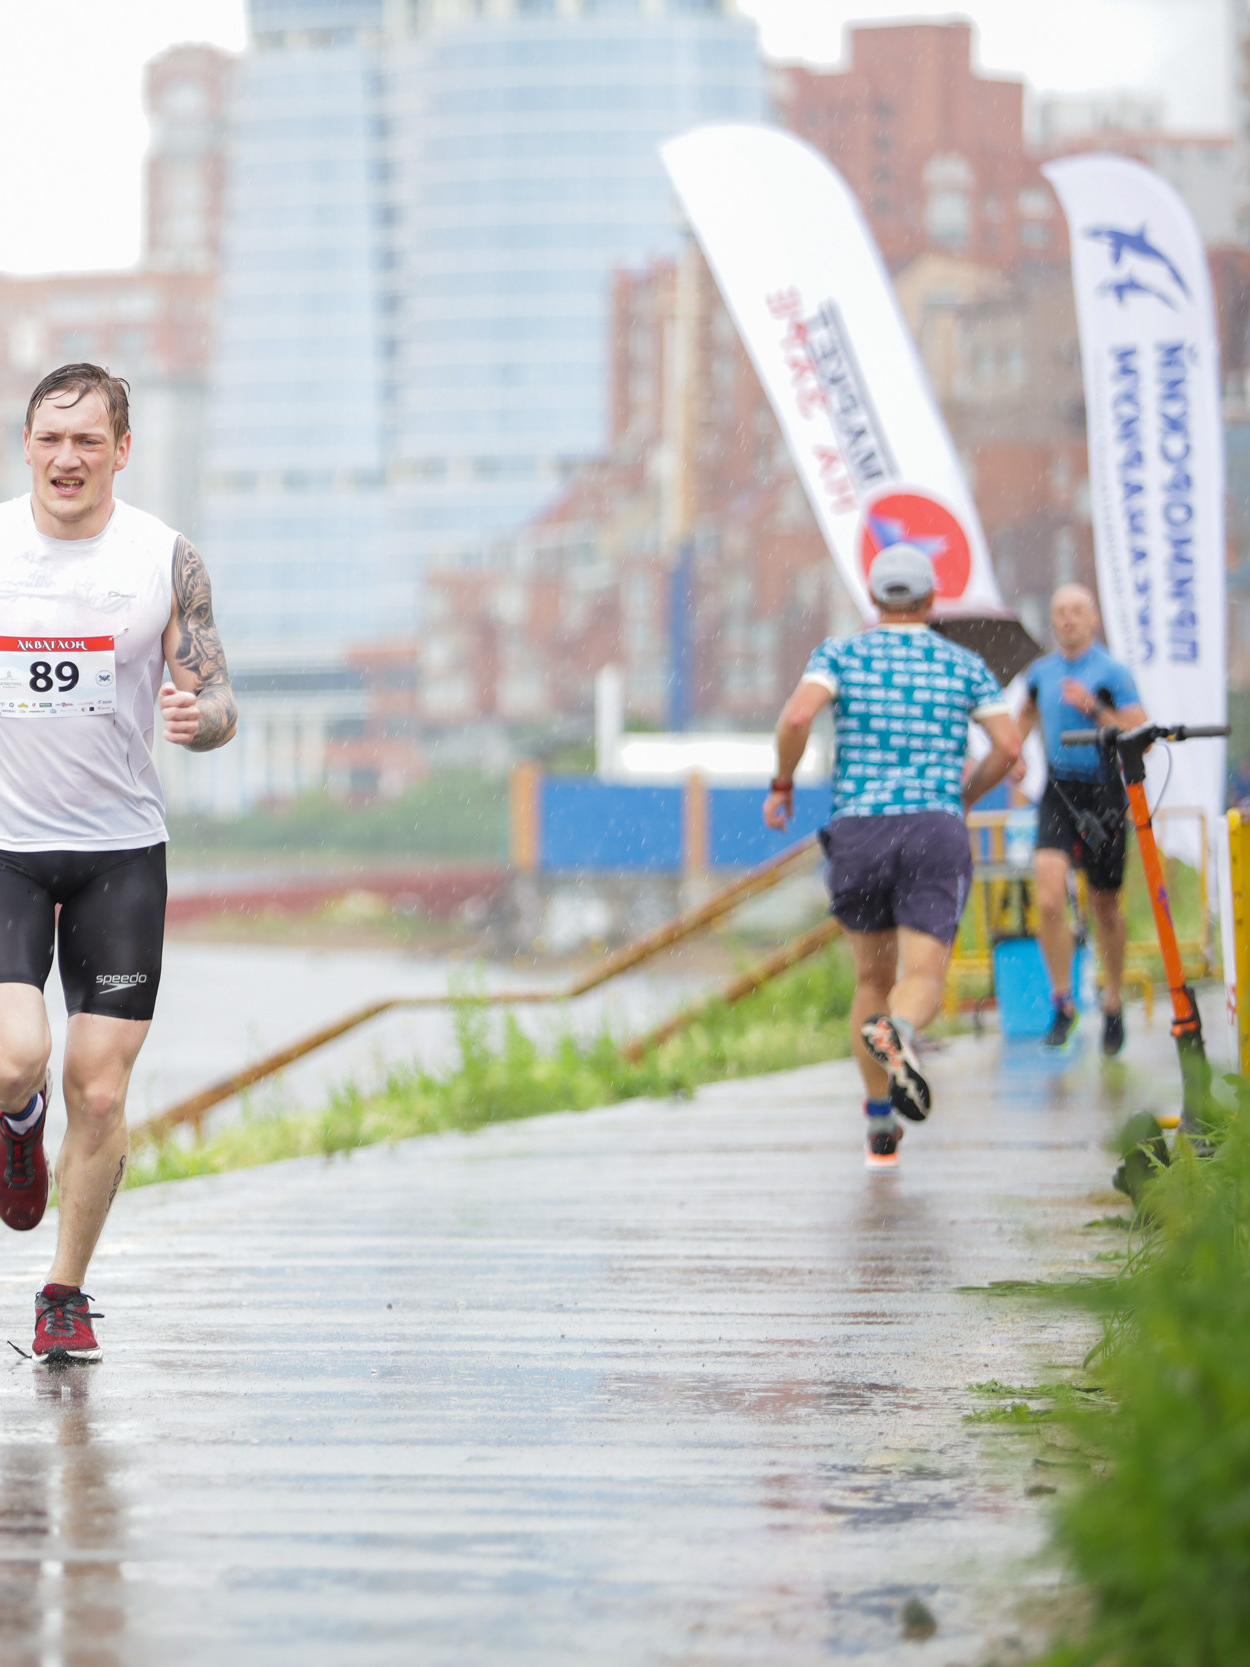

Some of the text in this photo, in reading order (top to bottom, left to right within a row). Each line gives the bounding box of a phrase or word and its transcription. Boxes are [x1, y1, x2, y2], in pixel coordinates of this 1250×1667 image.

[17, 639, 88, 651] АКВАТЛОН
[29, 661, 80, 692] 89
[95, 972, 147, 985] speedo
[105, 1154, 127, 1213] 89
